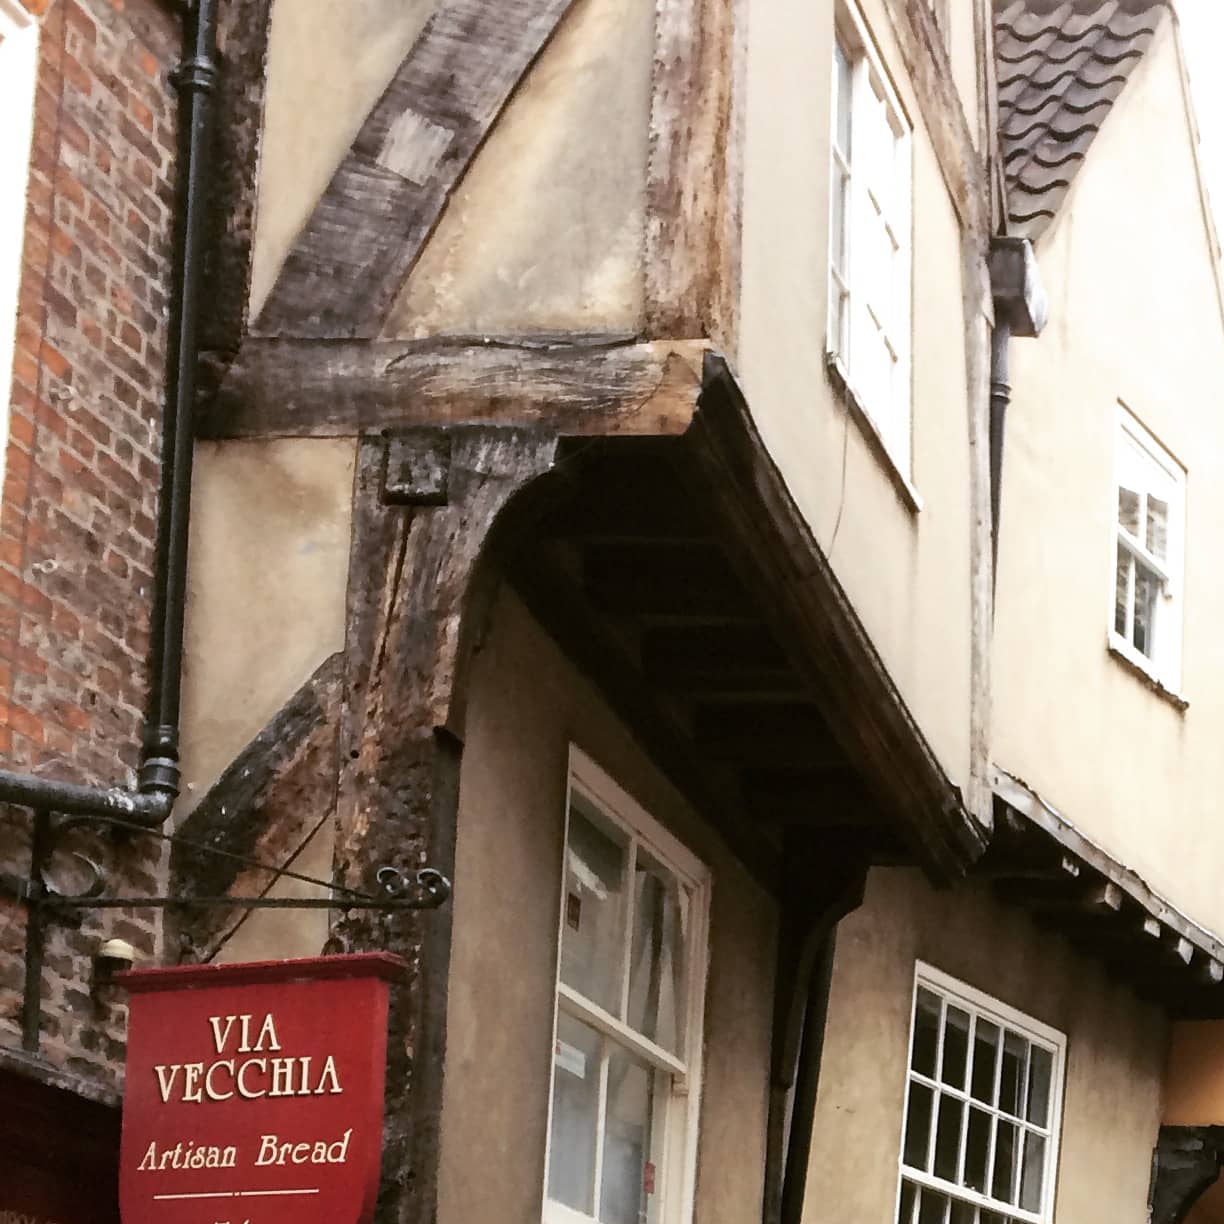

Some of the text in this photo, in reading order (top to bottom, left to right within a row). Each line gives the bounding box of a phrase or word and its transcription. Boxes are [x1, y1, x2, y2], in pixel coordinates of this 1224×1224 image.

[209, 1013, 282, 1054] VIA
[154, 1055, 343, 1104] VECCHIA
[137, 1128, 353, 1172] Artisan Bread
